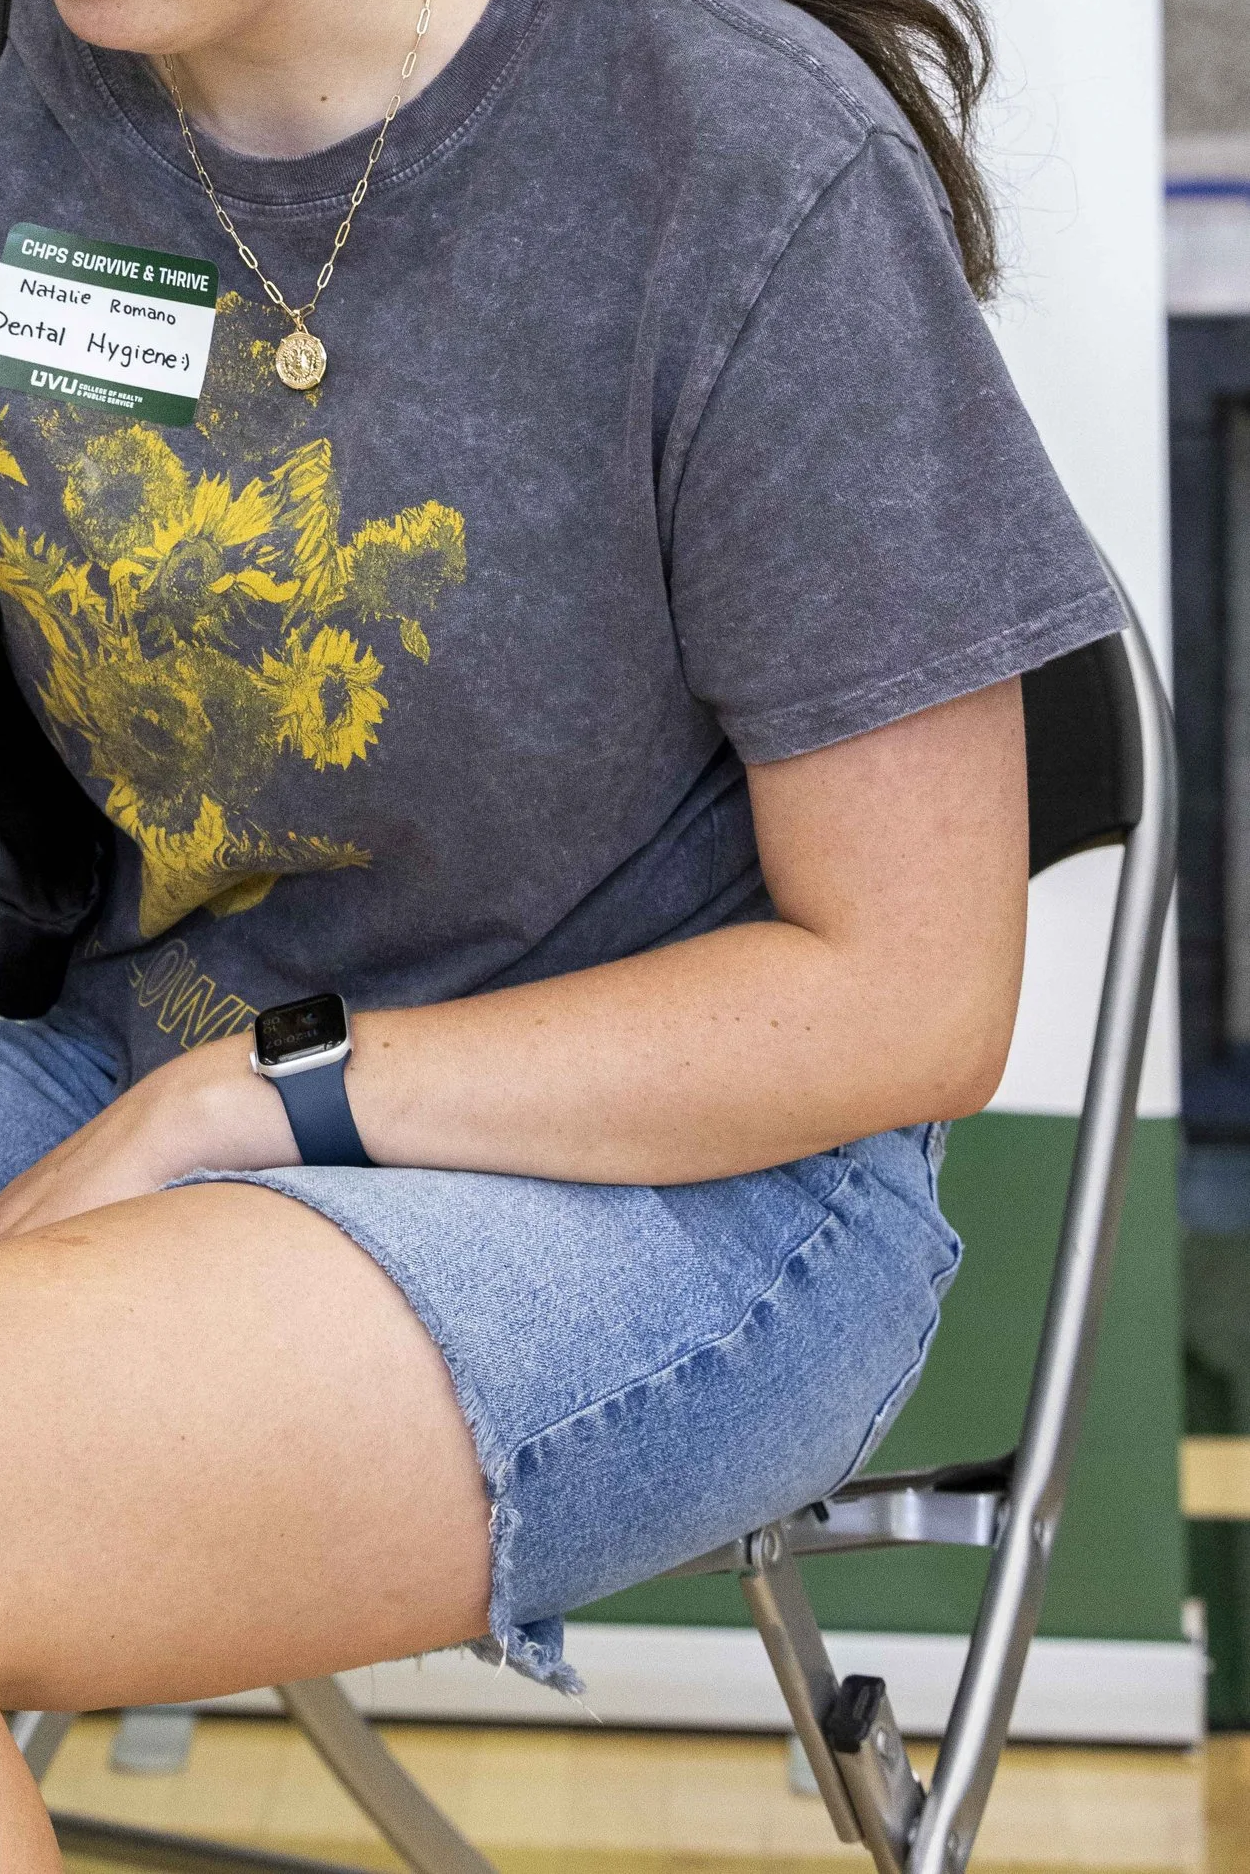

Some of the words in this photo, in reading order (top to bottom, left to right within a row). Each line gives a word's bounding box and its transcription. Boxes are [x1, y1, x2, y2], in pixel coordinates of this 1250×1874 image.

[21, 238, 68, 264] CHPS
[71, 251, 140, 279] SURVIVE
[142, 265, 155, 282] &
[158, 267, 210, 293] THRIVE
[20, 278, 92, 305] Natalie
[109, 298, 177, 326] Romano
[30, 369, 79, 395] UVU
[78, 383, 108, 396] COLLEGE
[108, 389, 118, 397] OF
[117, 392, 144, 403] HEALTH
[83, 391, 107, 403] PUBLIC
[106, 397, 135, 409] SERVICE
